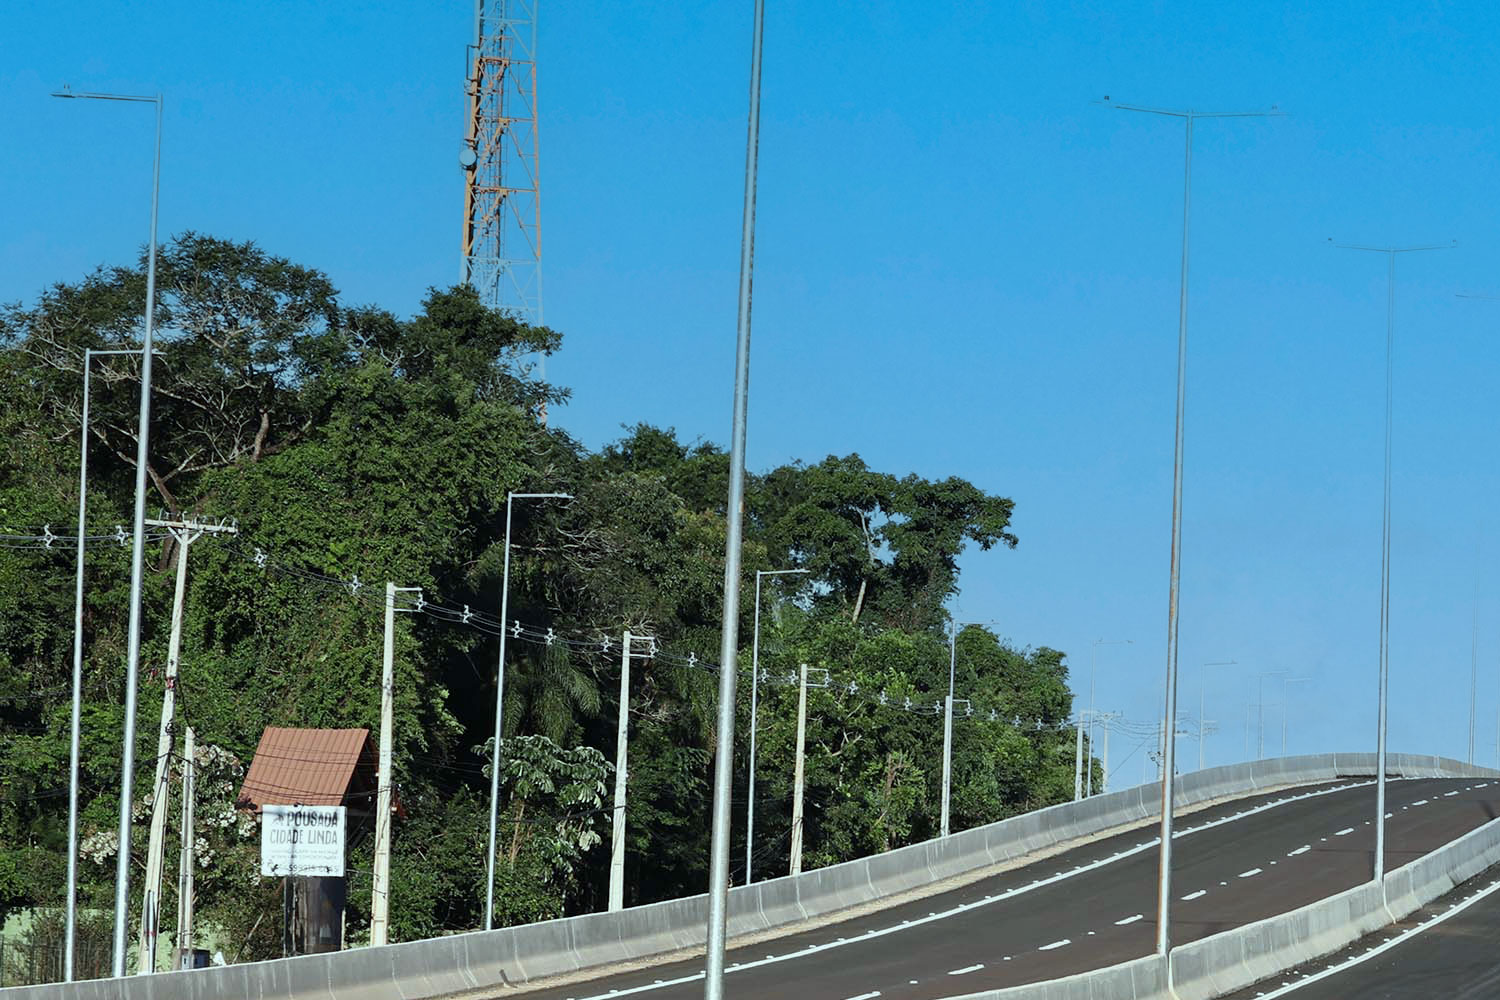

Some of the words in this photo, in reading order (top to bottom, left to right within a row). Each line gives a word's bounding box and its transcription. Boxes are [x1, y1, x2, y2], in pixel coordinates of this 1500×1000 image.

[287, 811, 338, 827] POUSADA
[270, 829, 304, 844] CIDADE
[308, 830, 338, 844] LINDA
